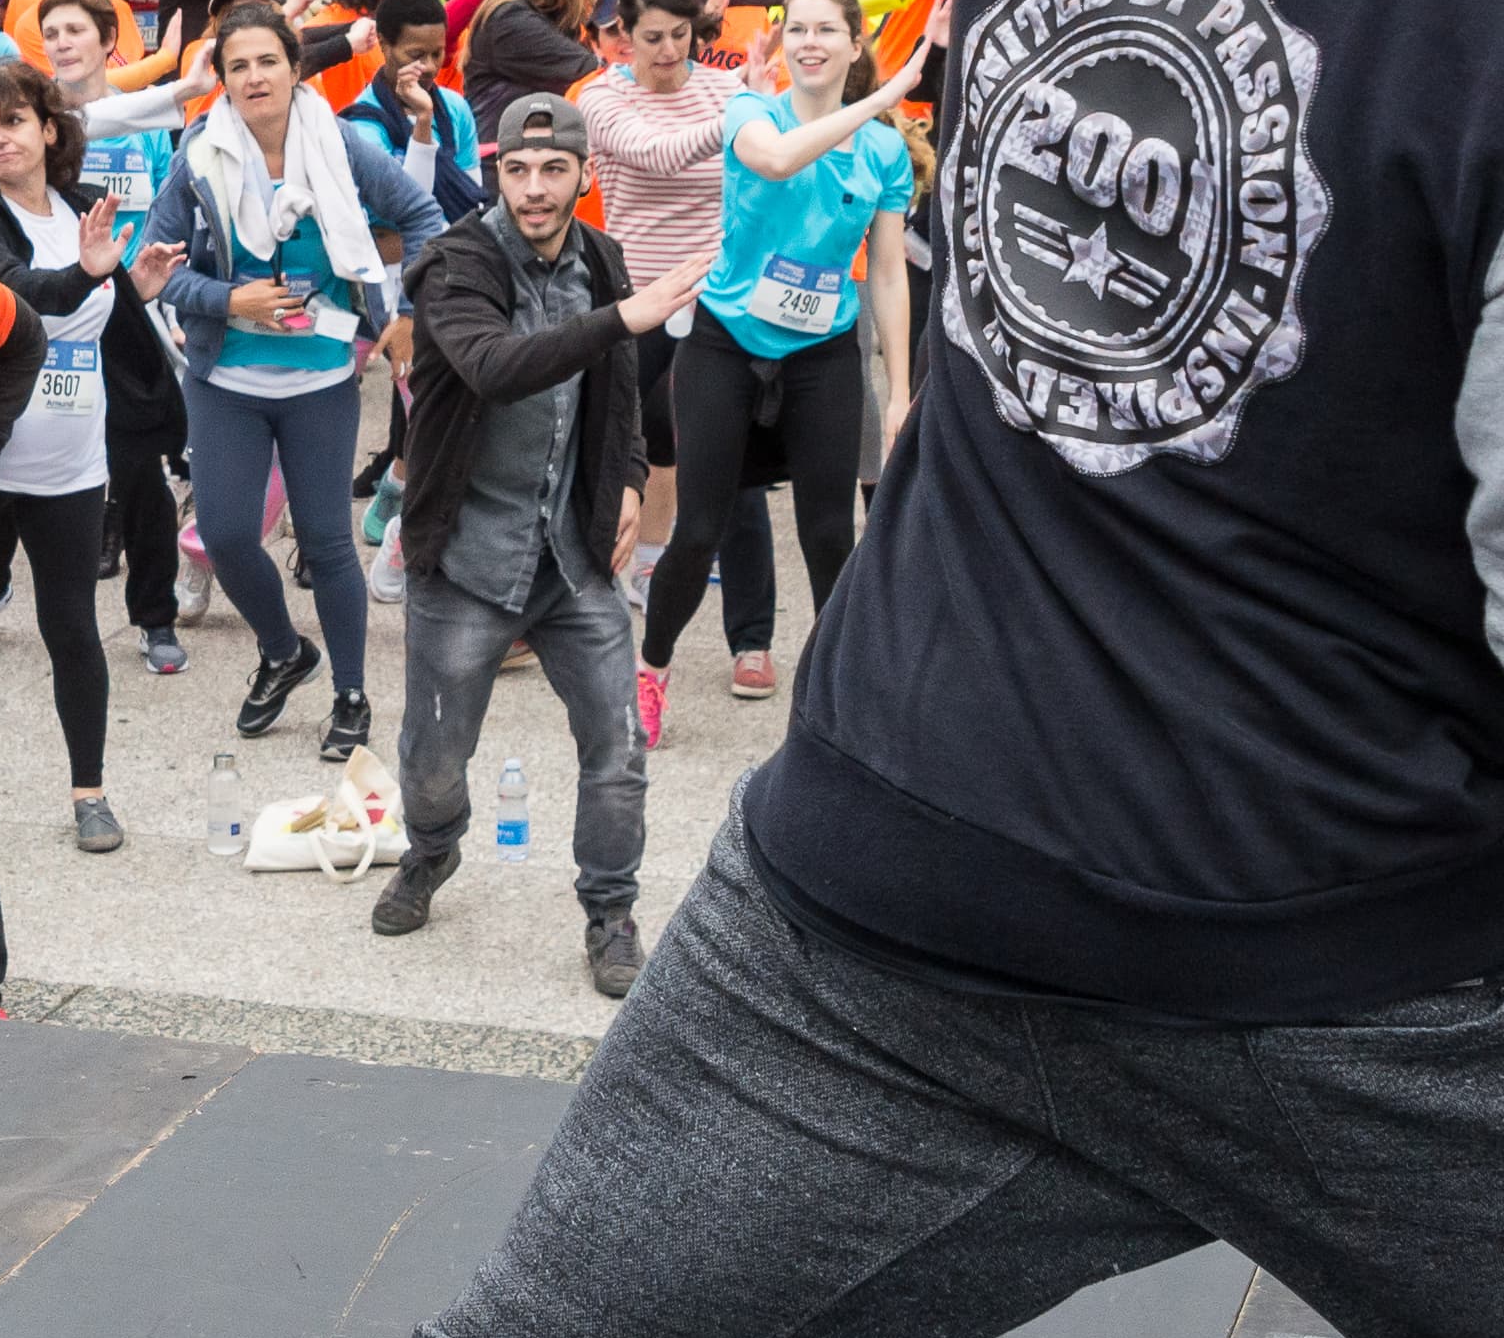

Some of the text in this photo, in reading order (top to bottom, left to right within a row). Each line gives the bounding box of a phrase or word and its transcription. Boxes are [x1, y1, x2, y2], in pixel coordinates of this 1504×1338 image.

[778, 289, 821, 316] 2490
[1016, 288, 1272, 432] INSPIRED
[42, 373, 80, 397] 3607
